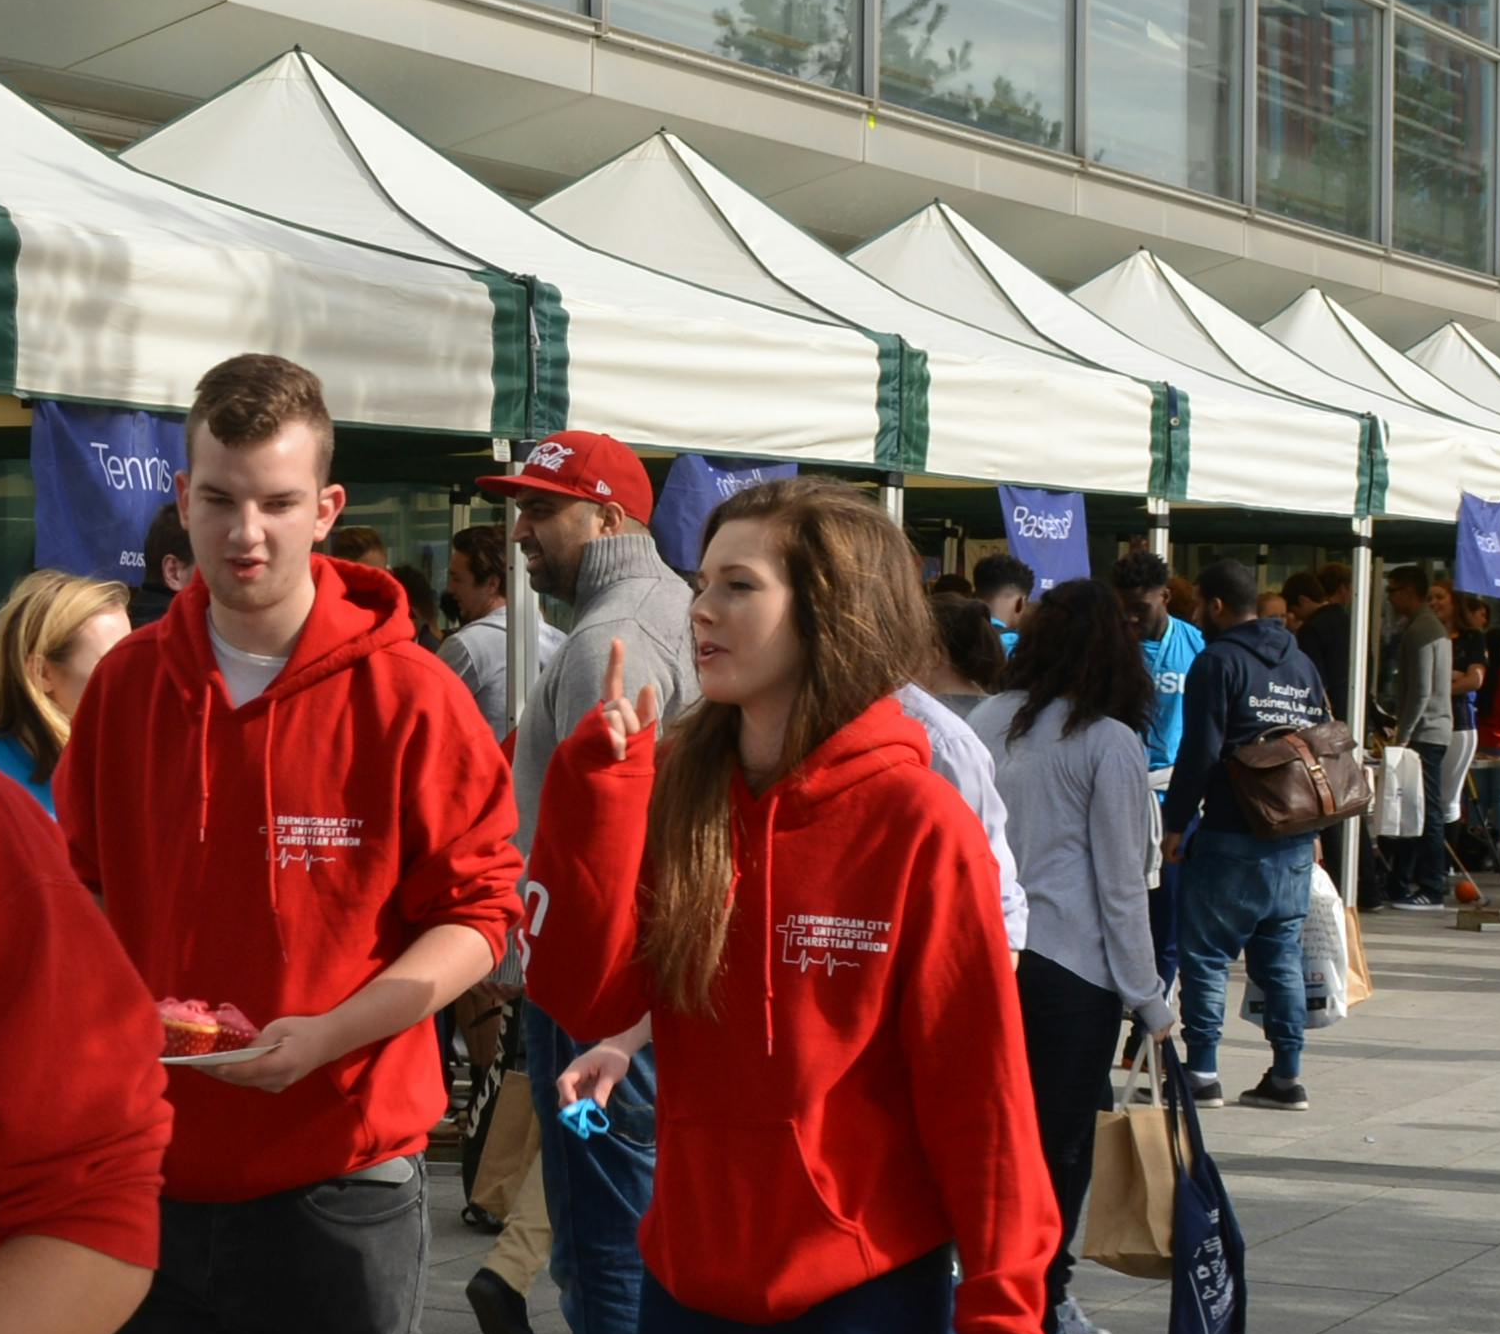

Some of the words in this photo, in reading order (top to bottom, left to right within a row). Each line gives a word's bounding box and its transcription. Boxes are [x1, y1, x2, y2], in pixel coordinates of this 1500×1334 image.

[89, 441, 174, 494] Tennis
[119, 550, 147, 568] BCUS
[1268, 681, 1299, 700] Faculty
[1299, 686, 1311, 699] of
[1255, 710, 1288, 724] Social
[276, 815, 338, 826] BIRMINGHAM
[340, 817, 364, 828] CITY
[290, 826, 349, 837] UNIVERSITY
[276, 835, 330, 846] CHRISTIAN
[331, 837, 362, 847] UNION
[796, 914, 865, 930] BIRMINGHAM
[866, 920, 893, 932] CITY
[811, 926, 875, 941] UNIVERSITY
[795, 936, 855, 950] CHRISTIAN
[856, 940, 890, 953] UNION
